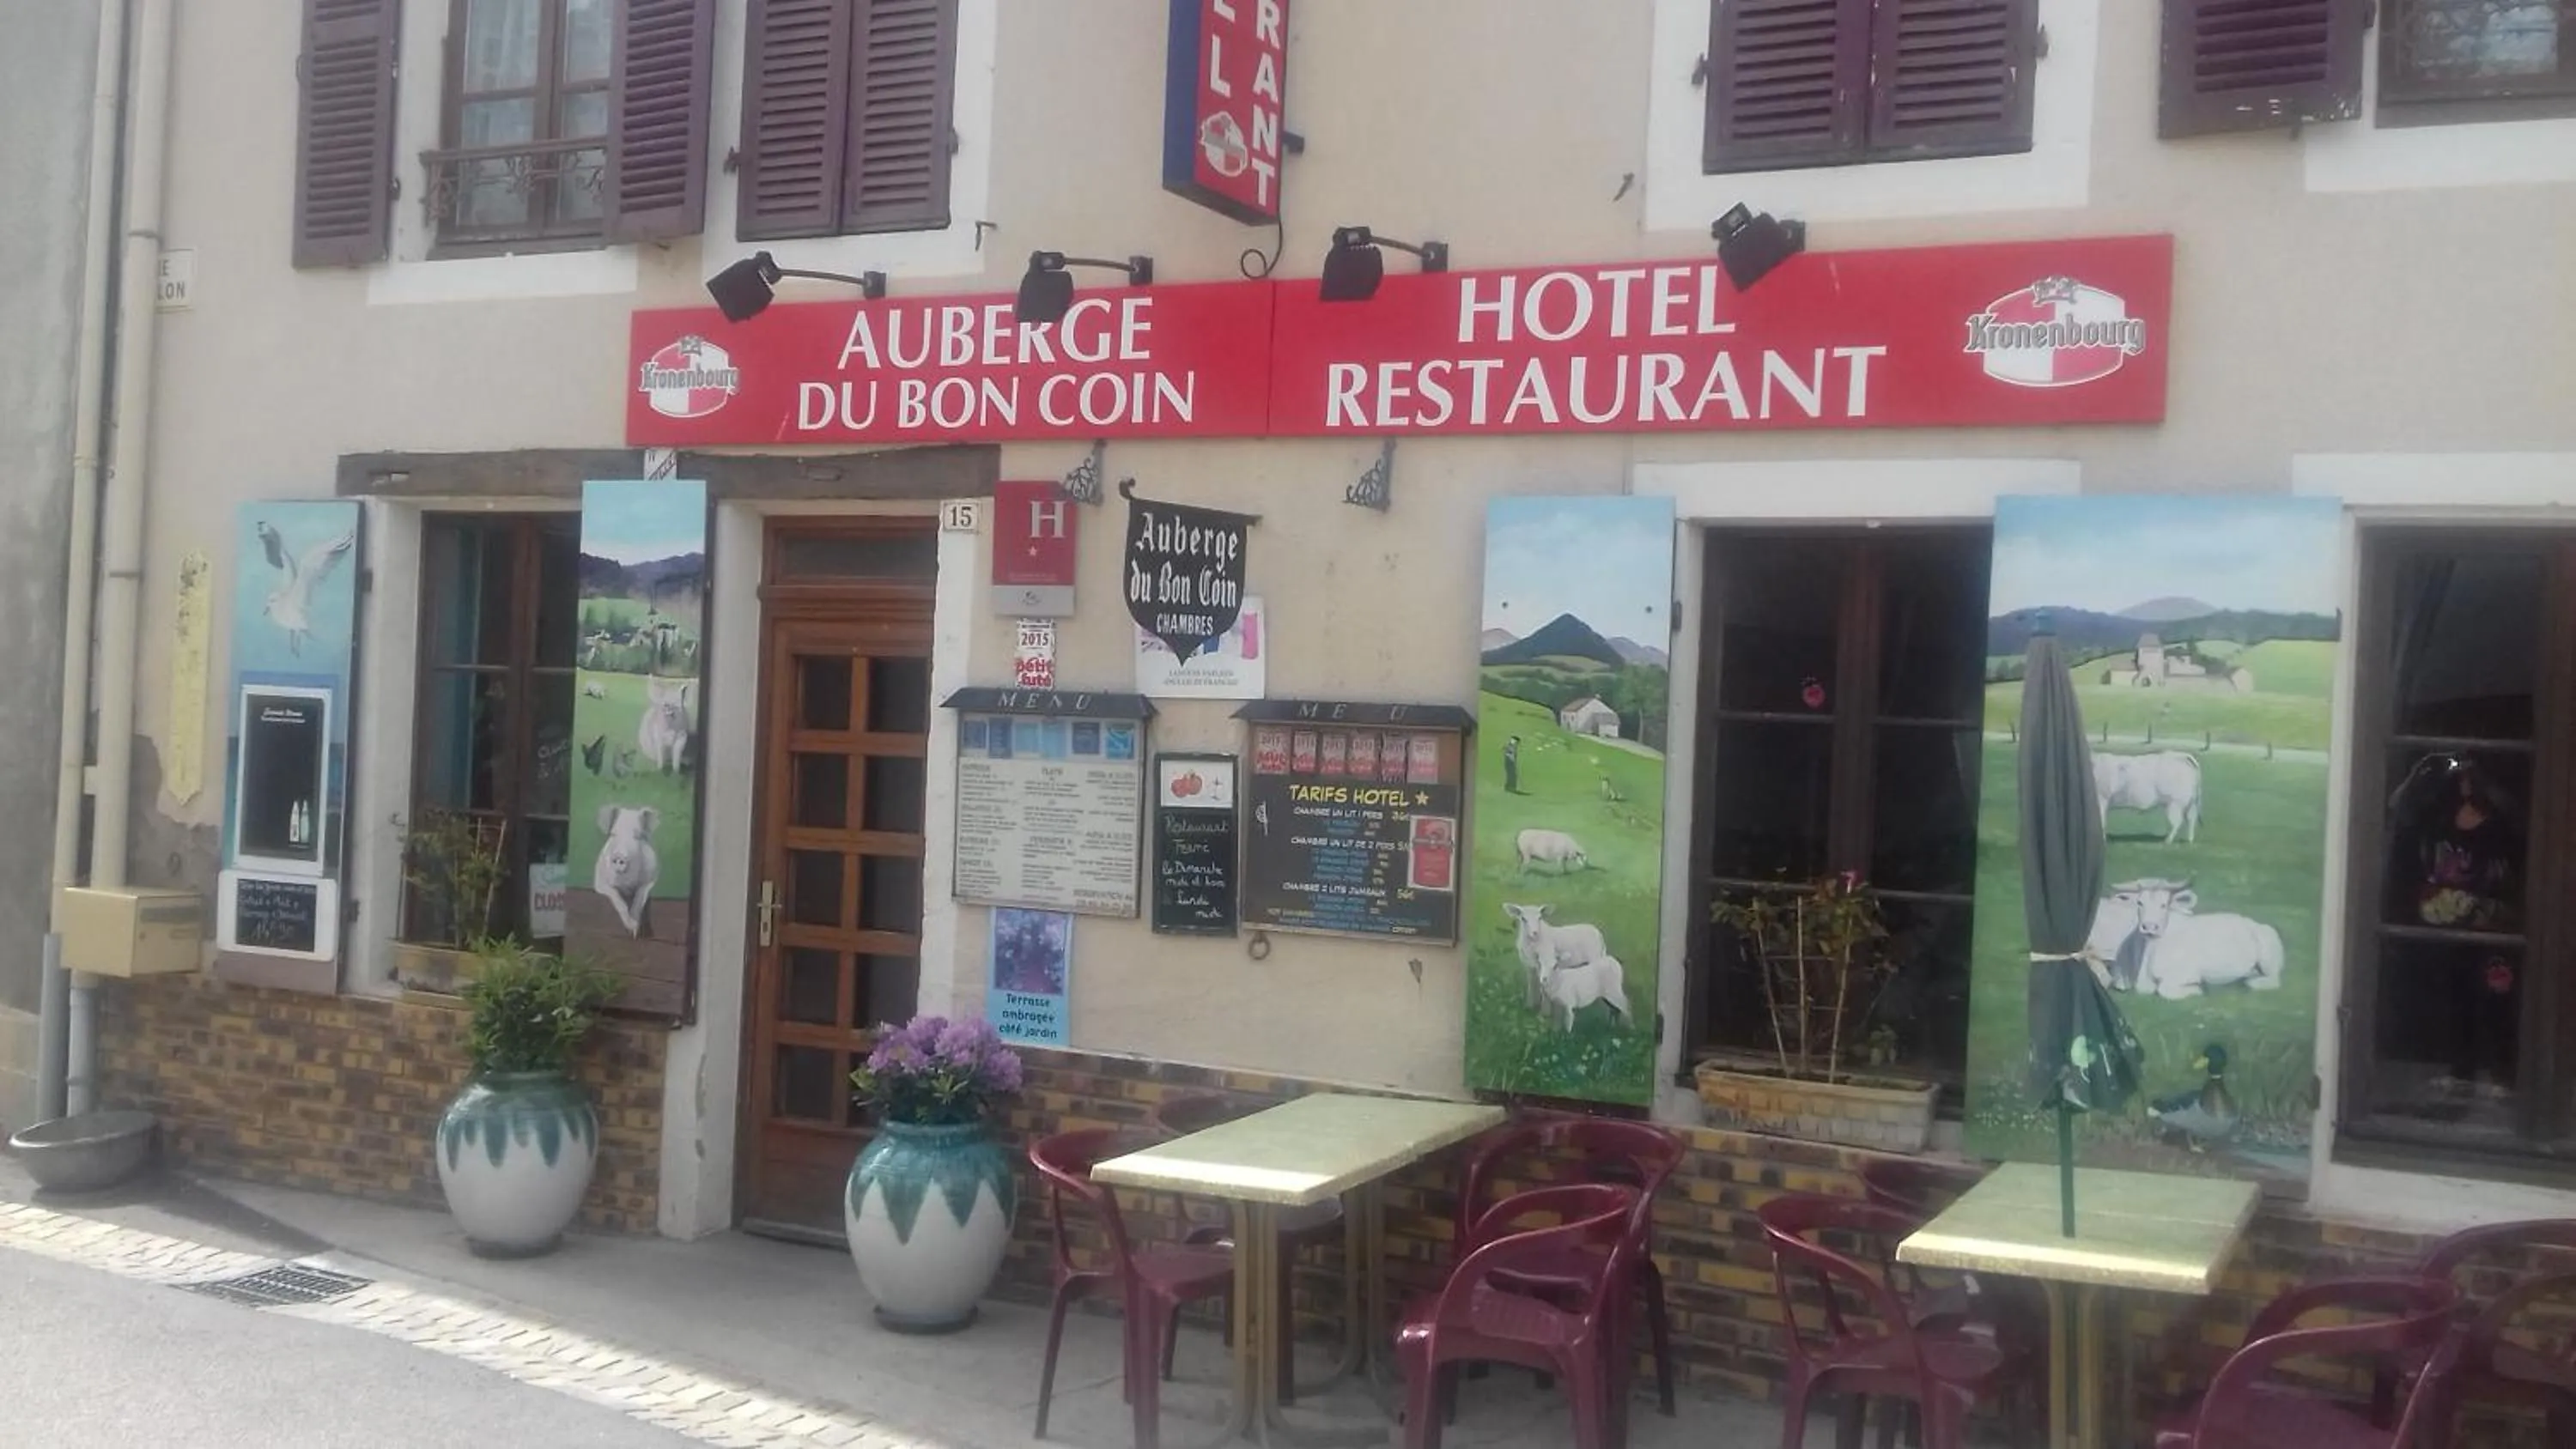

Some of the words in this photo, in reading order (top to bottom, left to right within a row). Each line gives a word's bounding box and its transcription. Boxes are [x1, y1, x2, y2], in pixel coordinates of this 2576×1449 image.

[1458, 266, 1736, 343] HOTEL
[838, 297, 1153, 369] AUBERGE
[1965, 312, 2144, 355] Kronenbourg
[639, 361, 738, 395] Kronenbourg
[1325, 345, 1887, 428] RESTAURANT
[798, 382, 878, 430] DU
[897, 377, 1019, 429] BON
[1038, 370, 1194, 426] COIN
[950, 506, 973, 527] 15
[1030, 500, 1064, 538] H
[1135, 512, 1238, 571] Auberge
[1130, 557, 1151, 602] du
[1158, 560, 1191, 604] Bon
[1199, 565, 1236, 608] Coin
[1021, 633, 1049, 646] 2015
[1157, 613, 1213, 636] CHAMBRES
[1289, 784, 1347, 803] TARIFS
[1353, 788, 1410, 806] HOTEL
[1005, 993, 1051, 1008] Terrasse
[1024, 1026, 1058, 1040] jardin
